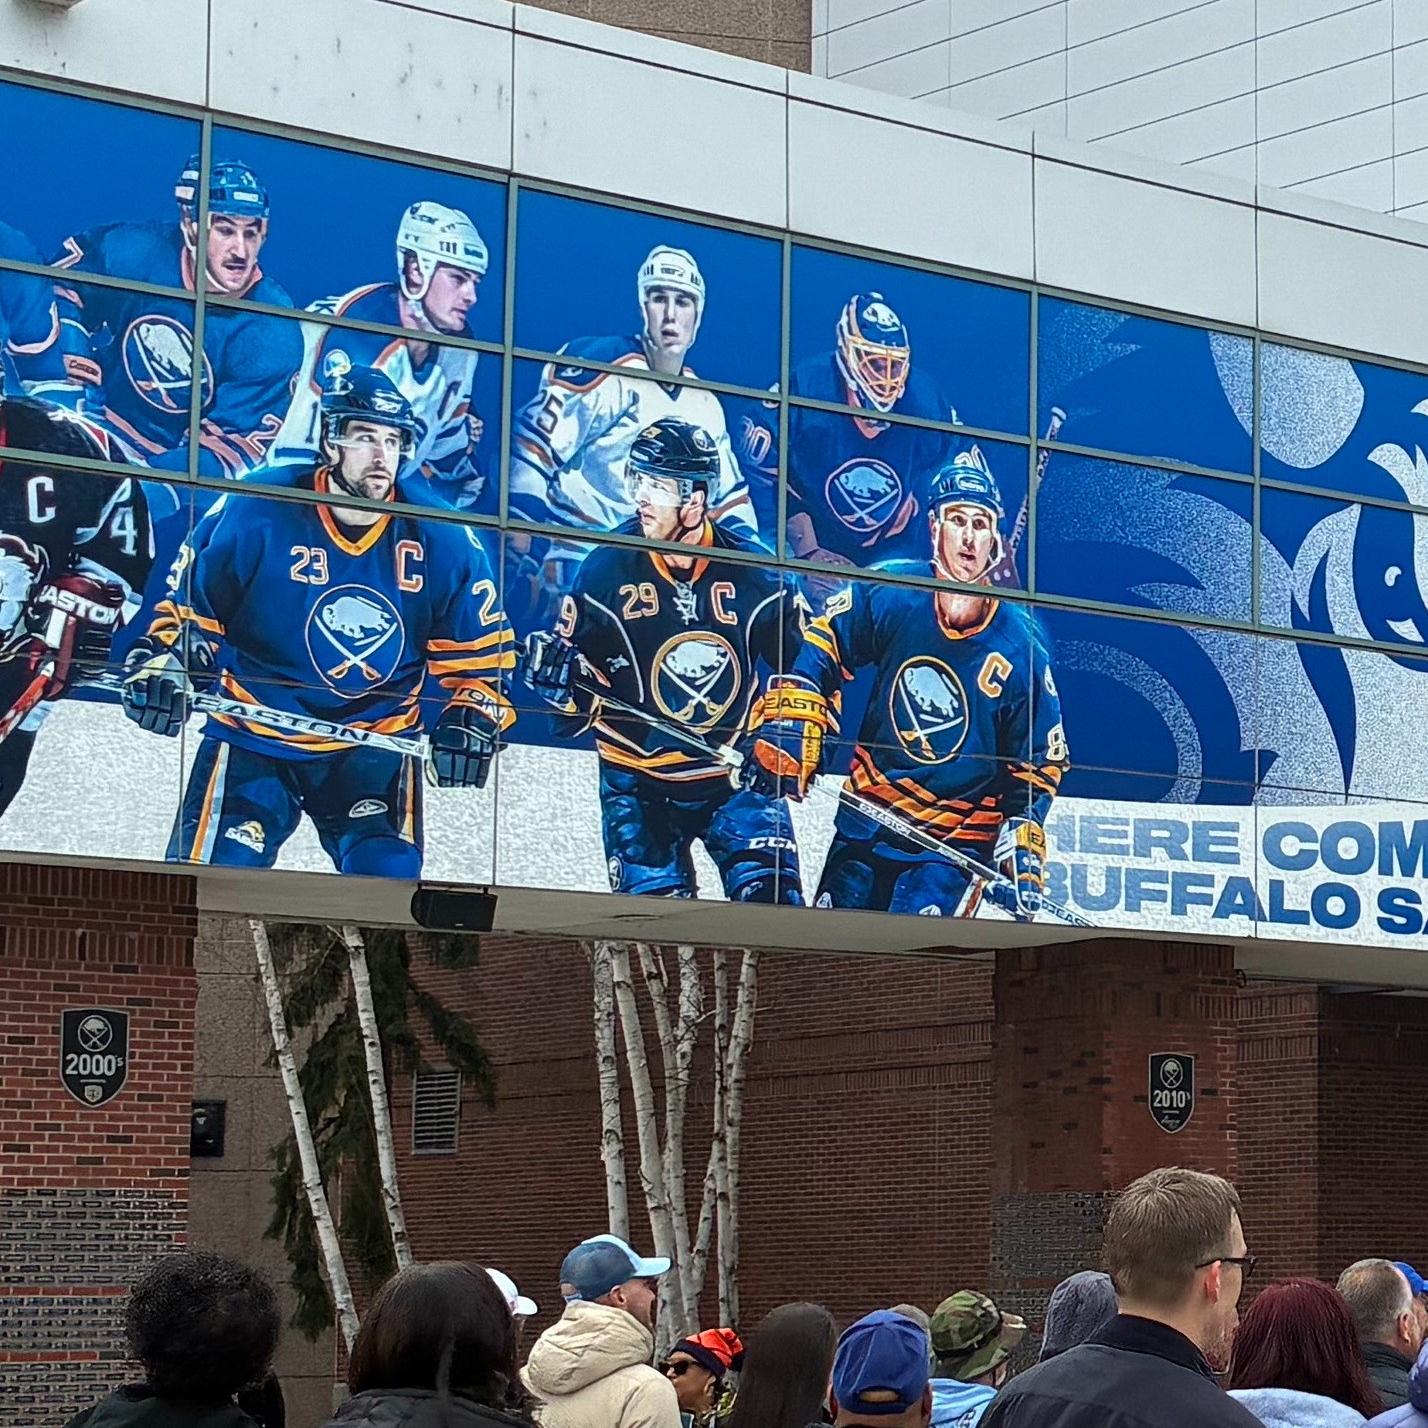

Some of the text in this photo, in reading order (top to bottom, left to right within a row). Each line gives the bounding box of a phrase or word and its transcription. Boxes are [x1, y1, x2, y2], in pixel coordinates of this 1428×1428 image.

[27, 476, 56, 523] C
[110, 506, 138, 556] 4
[290, 546, 329, 585] 23
[395, 540, 423, 593] C
[34, 584, 120, 625] ASTON
[471, 579, 506, 626] 2
[558, 595, 577, 638] 9
[619, 582, 658, 620] 29
[711, 581, 737, 625] C
[977, 652, 1013, 698] C
[192, 695, 372, 742] EASTON
[65, 1053, 124, 1076] 2000's
